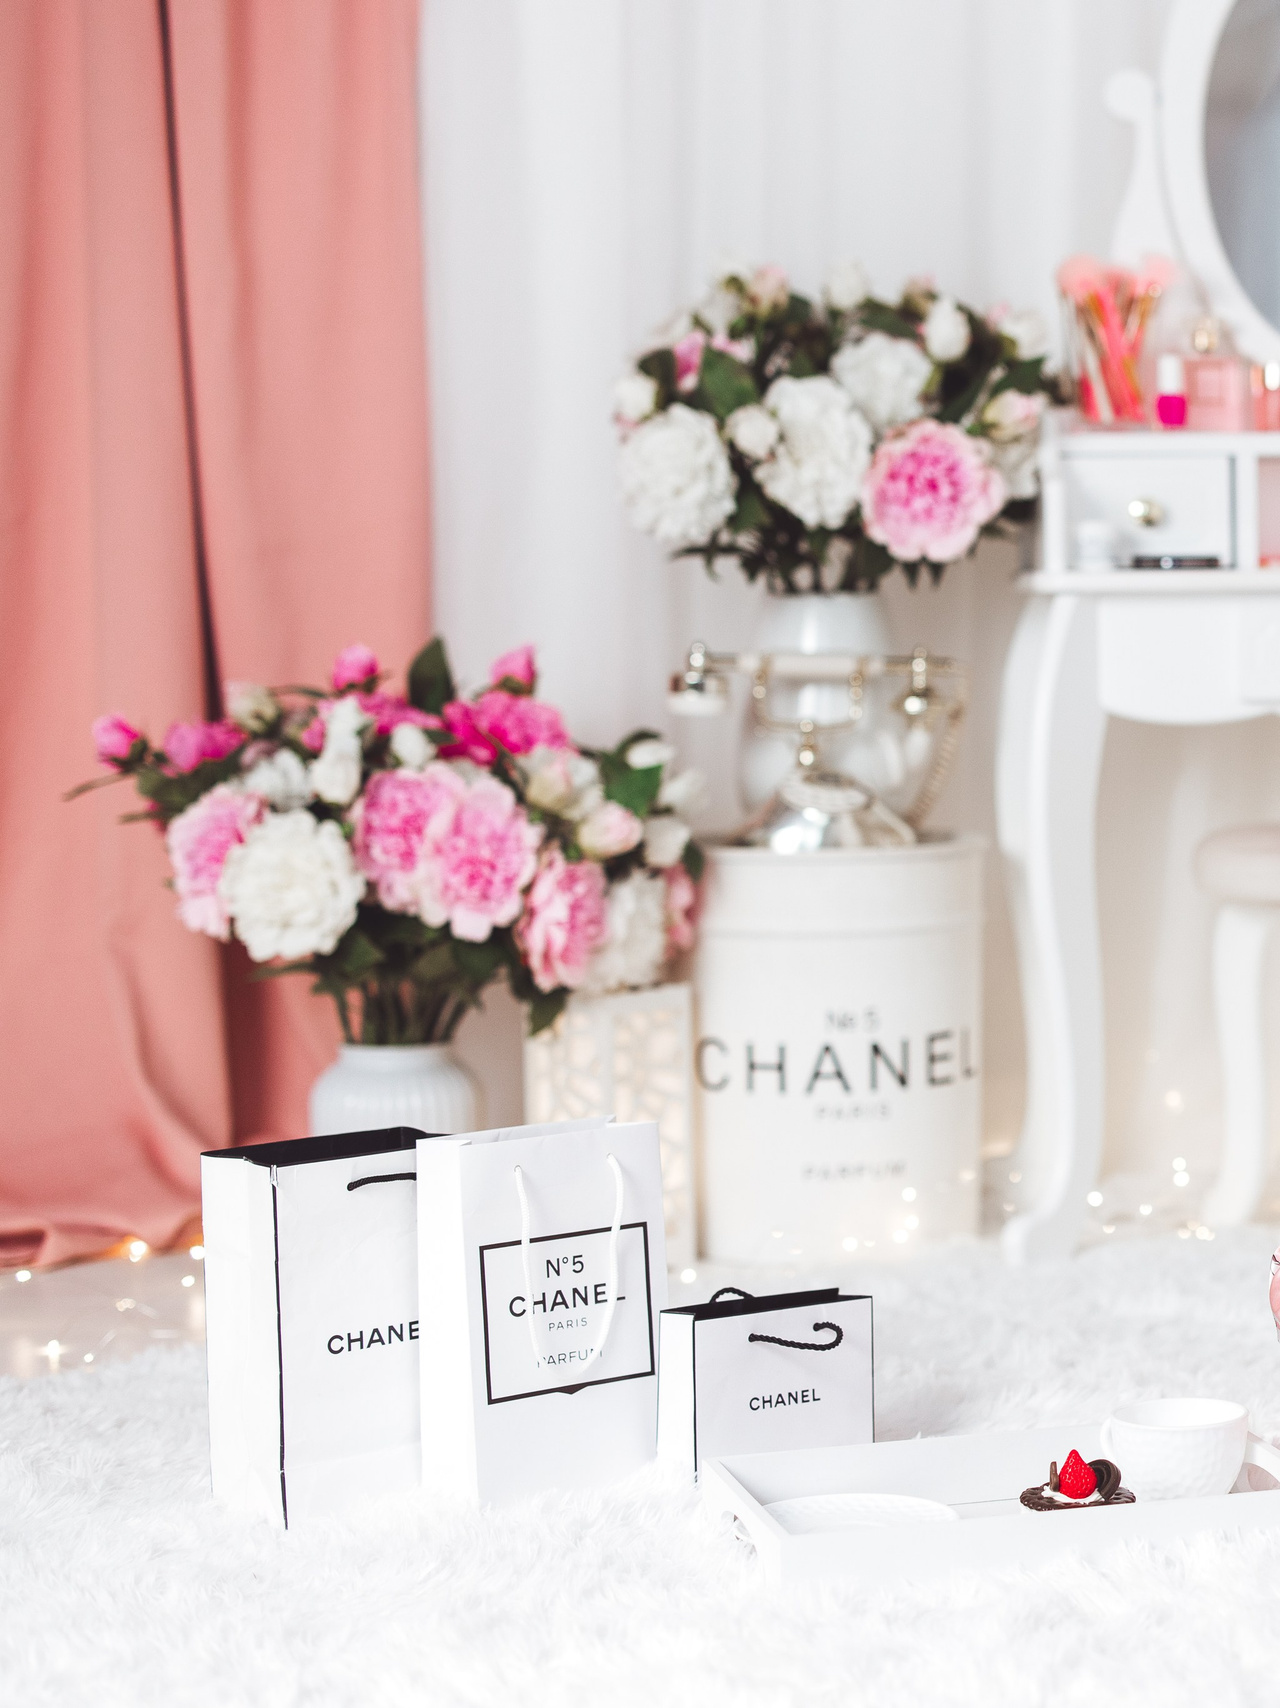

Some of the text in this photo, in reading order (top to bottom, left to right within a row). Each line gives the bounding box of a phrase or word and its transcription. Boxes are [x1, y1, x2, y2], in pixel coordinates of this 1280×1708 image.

[694, 1029, 976, 1093] CHANEL
[327, 1319, 420, 1355] CHANE
[548, 1317, 588, 1332] PARIS
[748, 1388, 821, 1411] CHANEL
